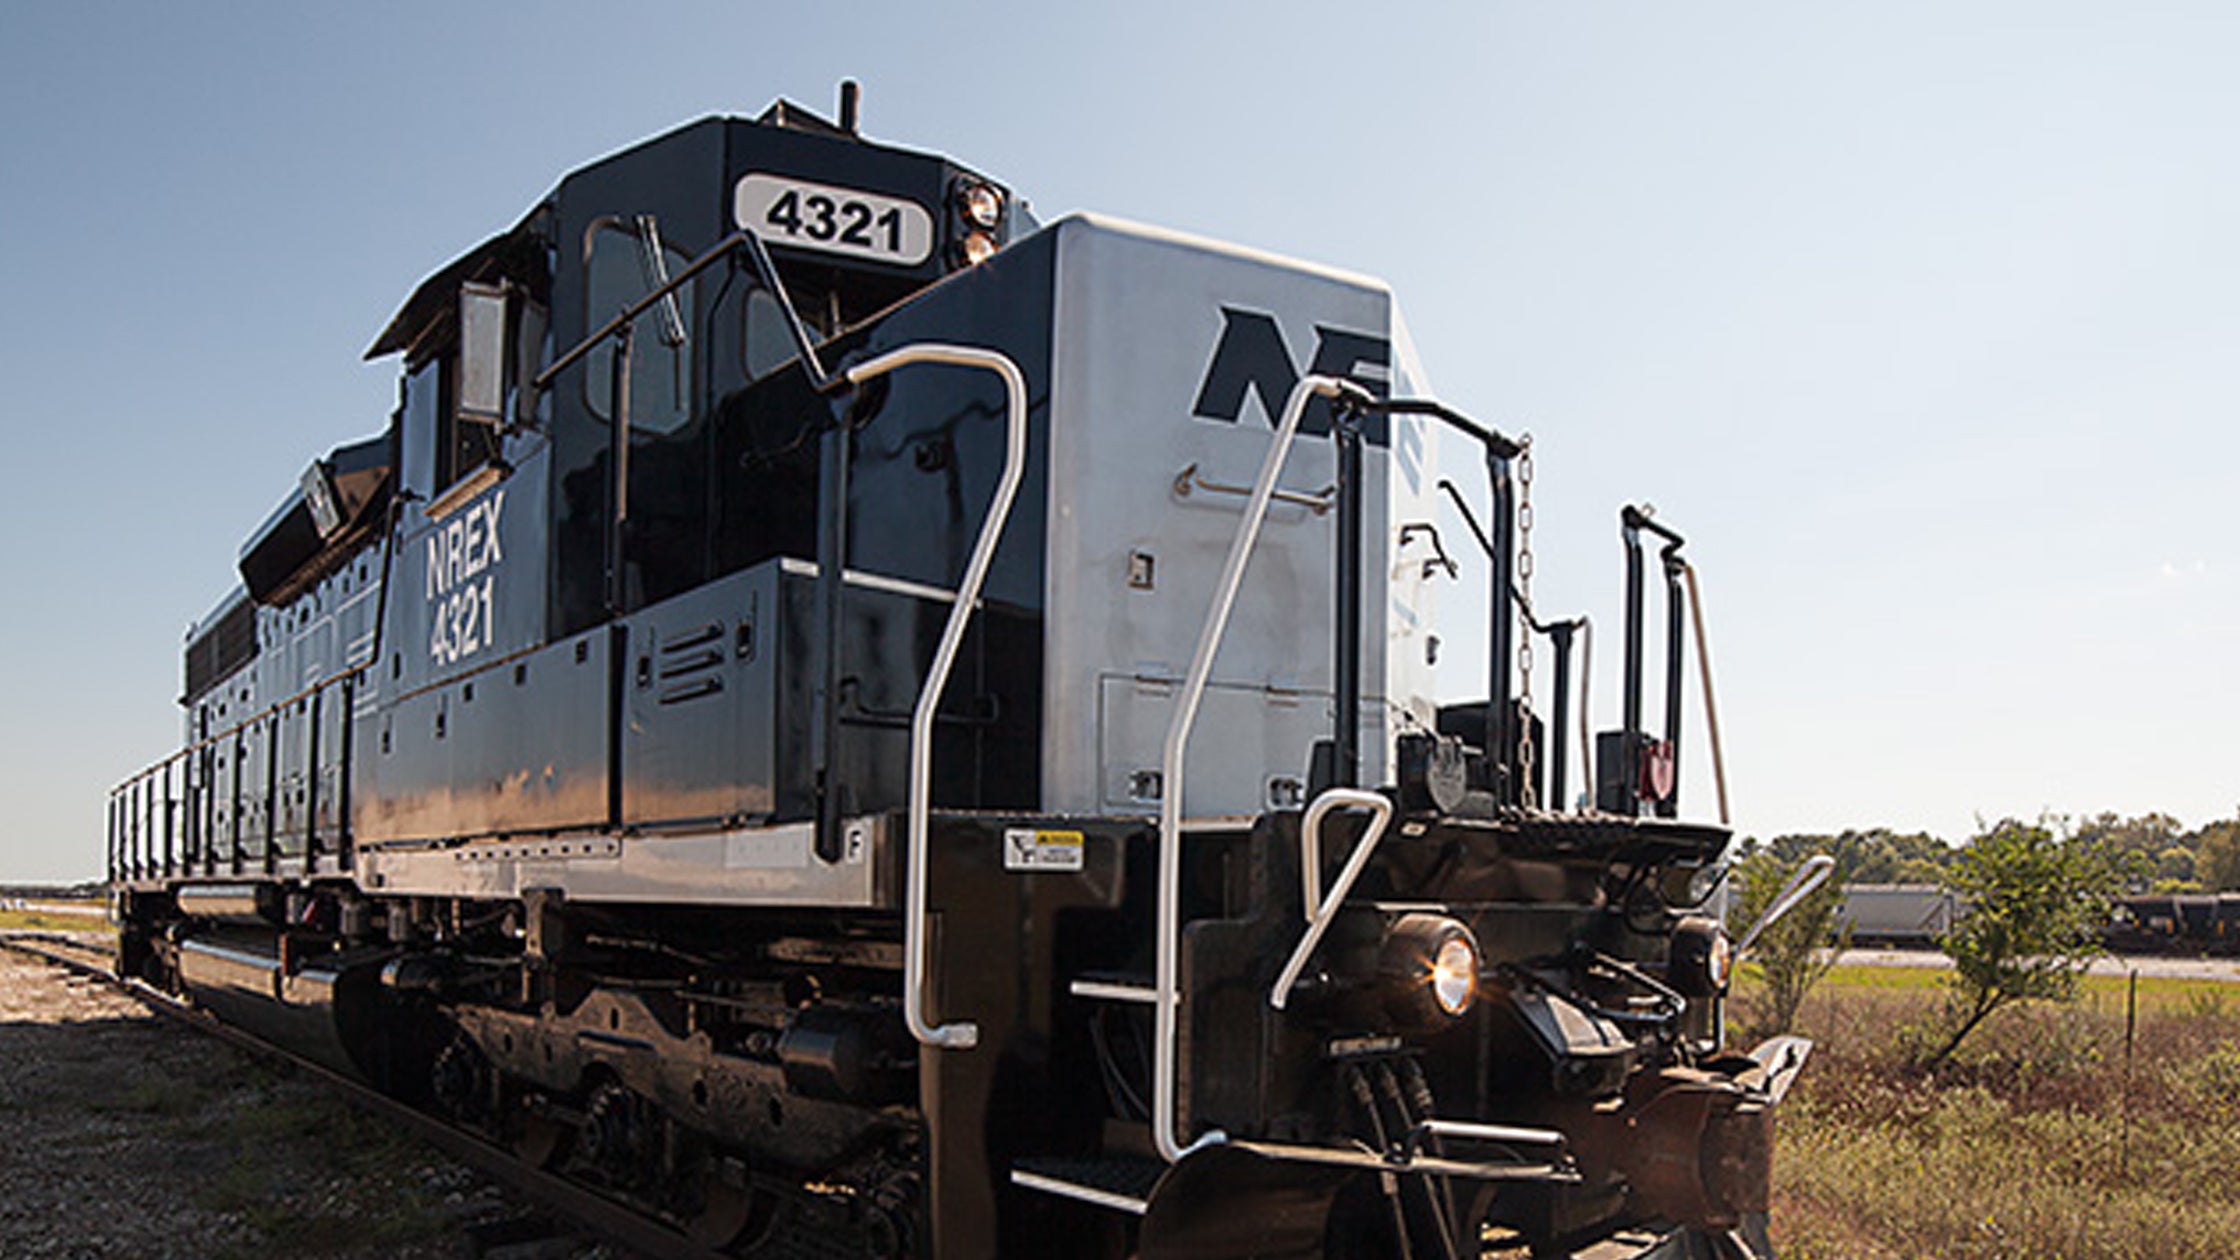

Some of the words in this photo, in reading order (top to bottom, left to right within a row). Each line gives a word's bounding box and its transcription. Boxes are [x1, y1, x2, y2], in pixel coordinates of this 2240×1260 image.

[766, 190, 901, 251] 4321
[426, 491, 504, 600] NREX
[431, 576, 493, 666] 4321
[849, 829, 862, 858] F
